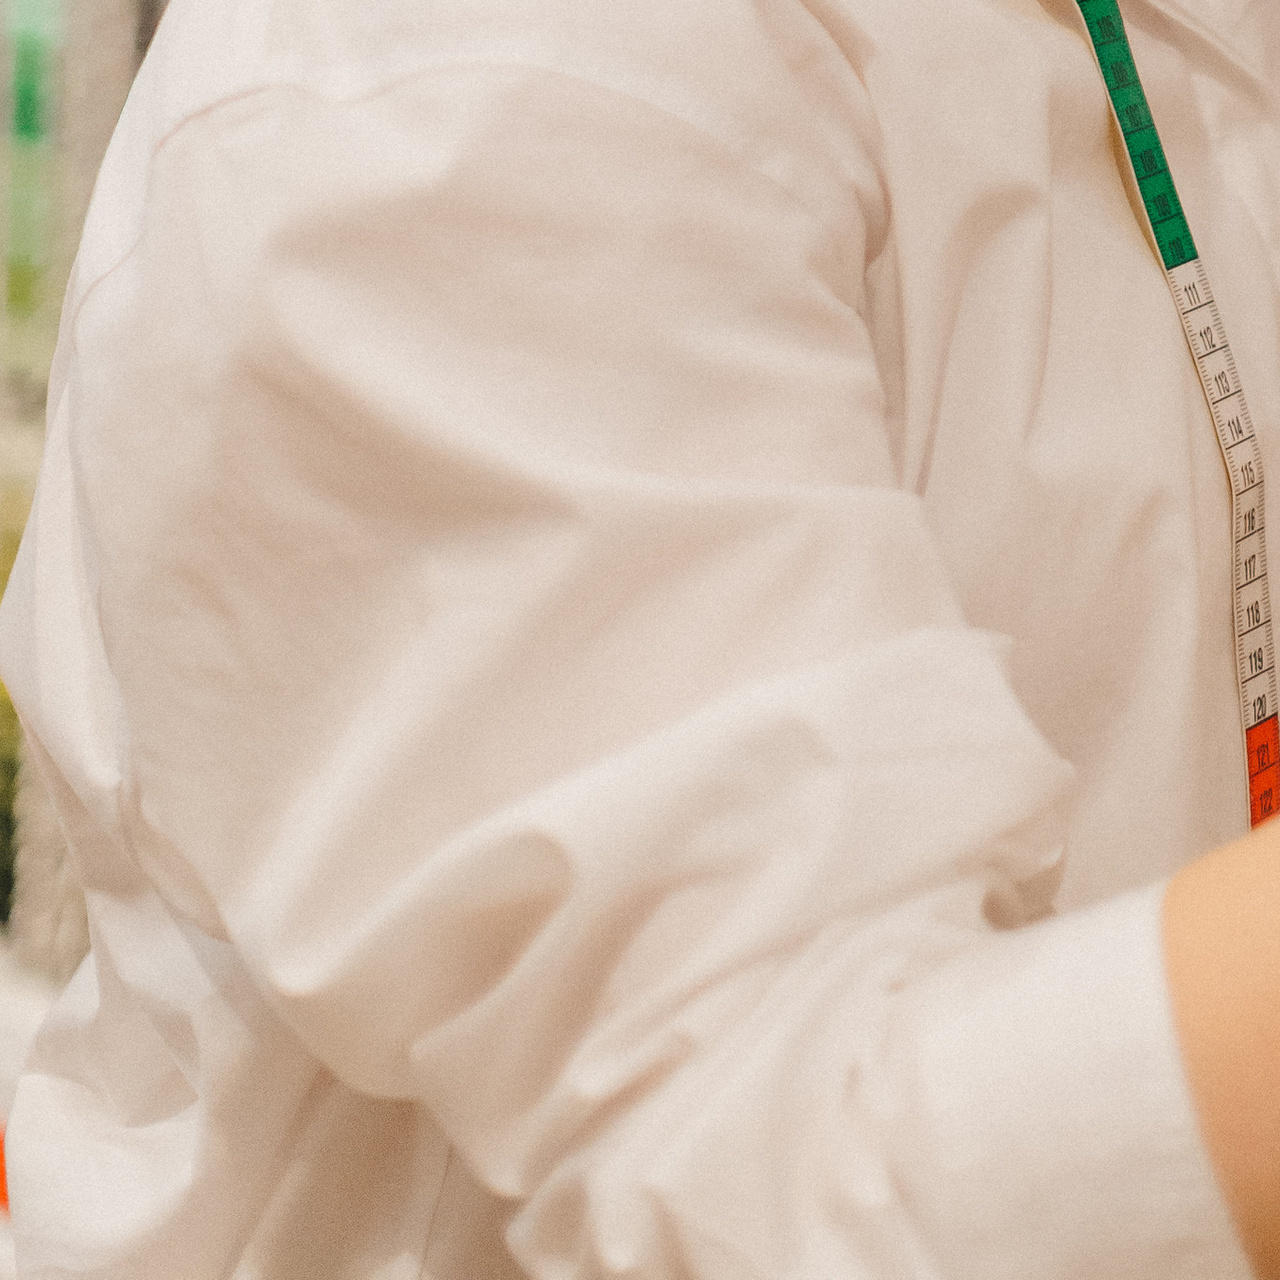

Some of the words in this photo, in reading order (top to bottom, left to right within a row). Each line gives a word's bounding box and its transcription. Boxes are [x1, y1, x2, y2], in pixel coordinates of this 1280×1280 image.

[1184, 282, 1201, 306] 111
[1199, 326, 1216, 350] 112
[1214, 371, 1230, 396] 113
[1227, 415, 1244, 440] 114
[1240, 461, 1255, 486] 115
[1244, 554, 1257, 581] 117
[1246, 600, 1261, 627] 118
[1248, 647, 1264, 675] 119
[1252, 693, 1267, 722] 120
[1256, 742, 1270, 770] 121
[1259, 787, 1273, 815] 122
